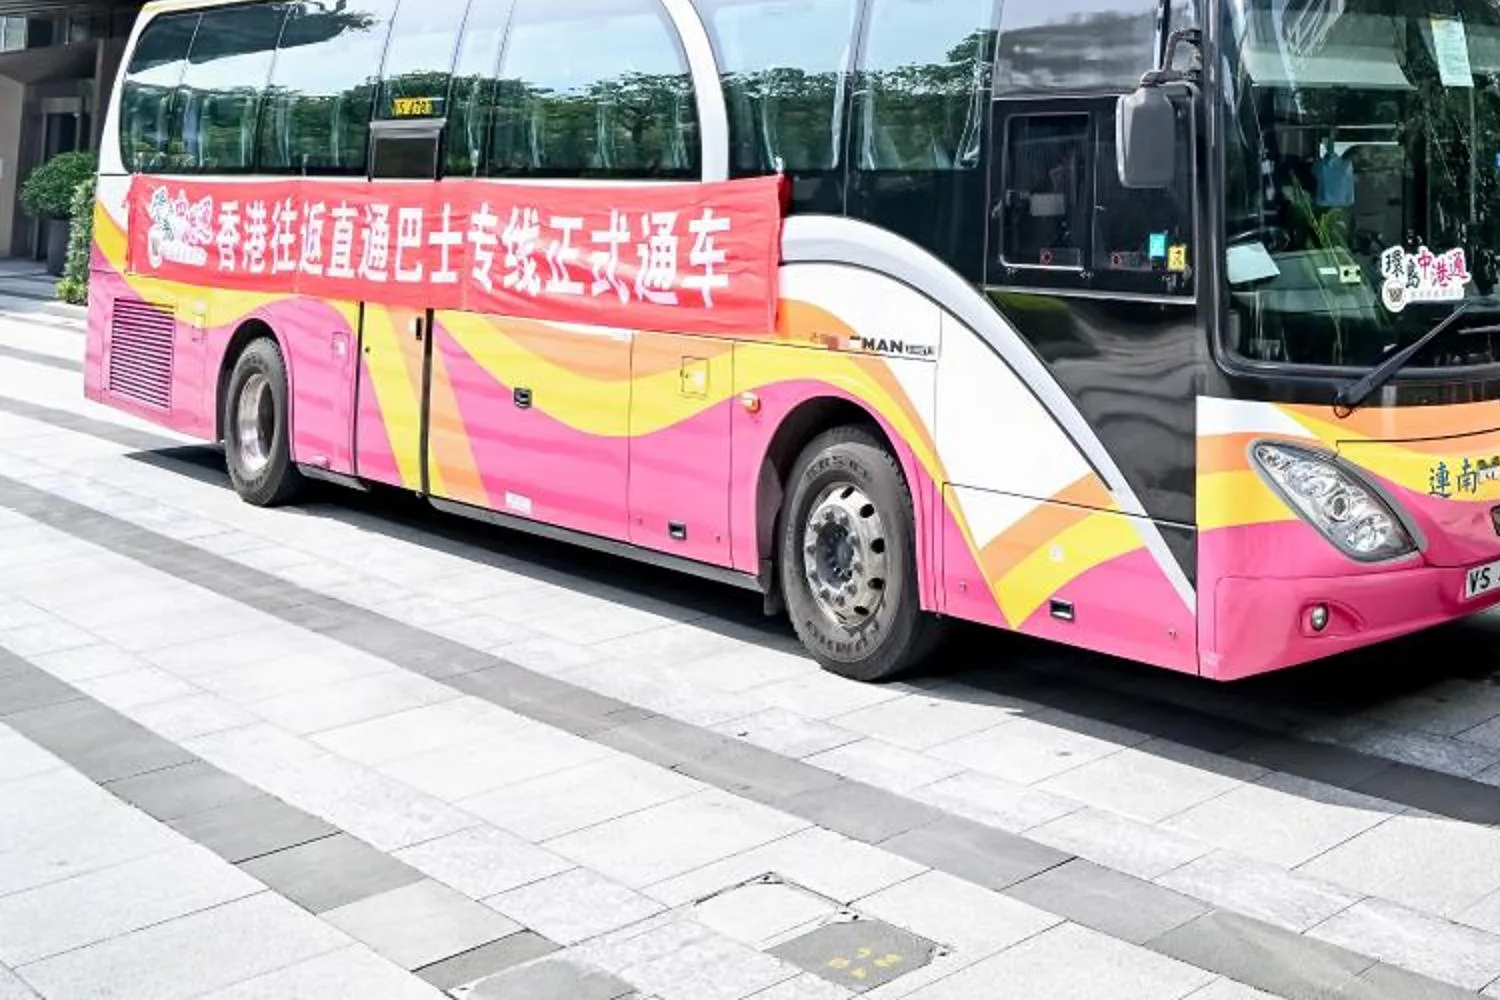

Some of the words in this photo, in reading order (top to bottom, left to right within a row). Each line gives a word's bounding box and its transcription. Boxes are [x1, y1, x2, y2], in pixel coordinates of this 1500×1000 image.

[216, 196, 732, 309] 香港往返直通巴士专线正式通车
[861, 337, 903, 353] MAN
[1469, 567, 1491, 593] VS
